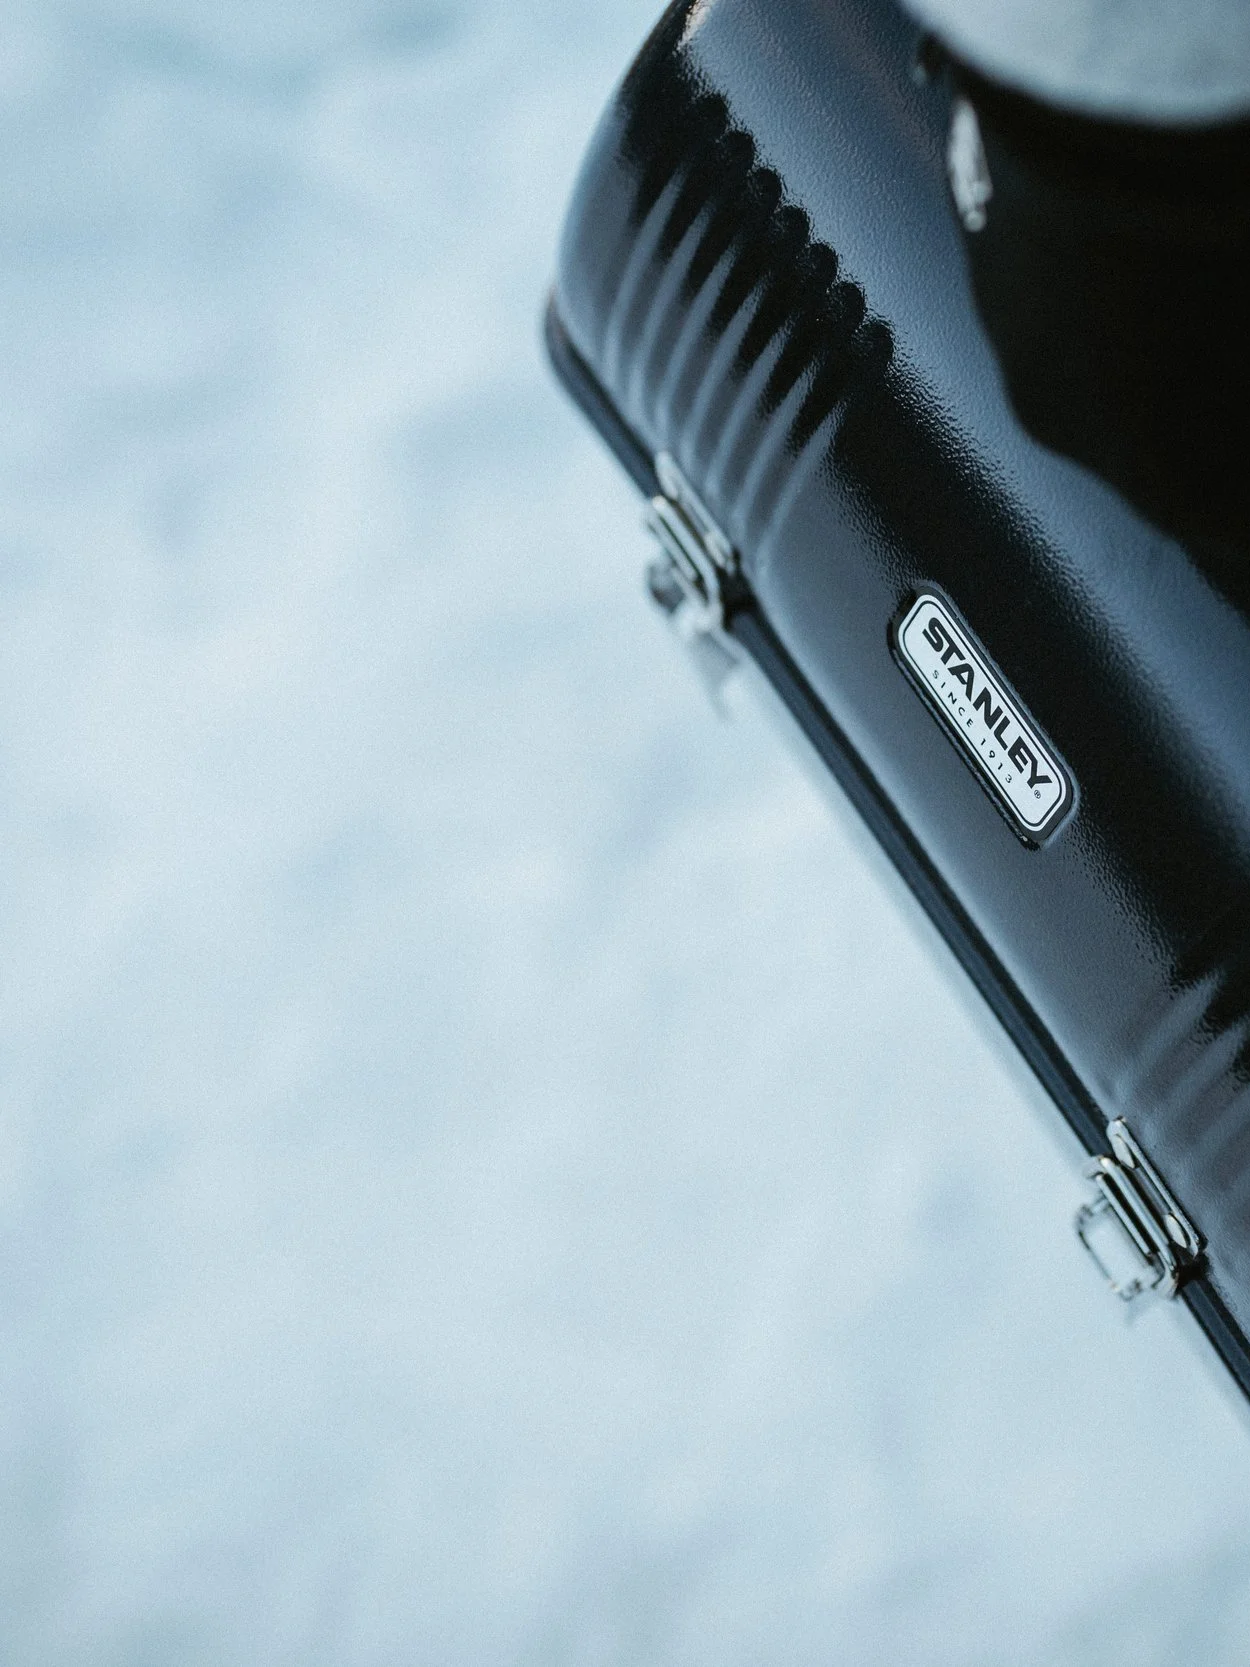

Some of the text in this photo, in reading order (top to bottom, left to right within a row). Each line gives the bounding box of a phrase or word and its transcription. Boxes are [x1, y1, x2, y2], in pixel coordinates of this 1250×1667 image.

[922, 617, 1053, 789] STANLEY
[932, 670, 1013, 783] SINCE 1913
